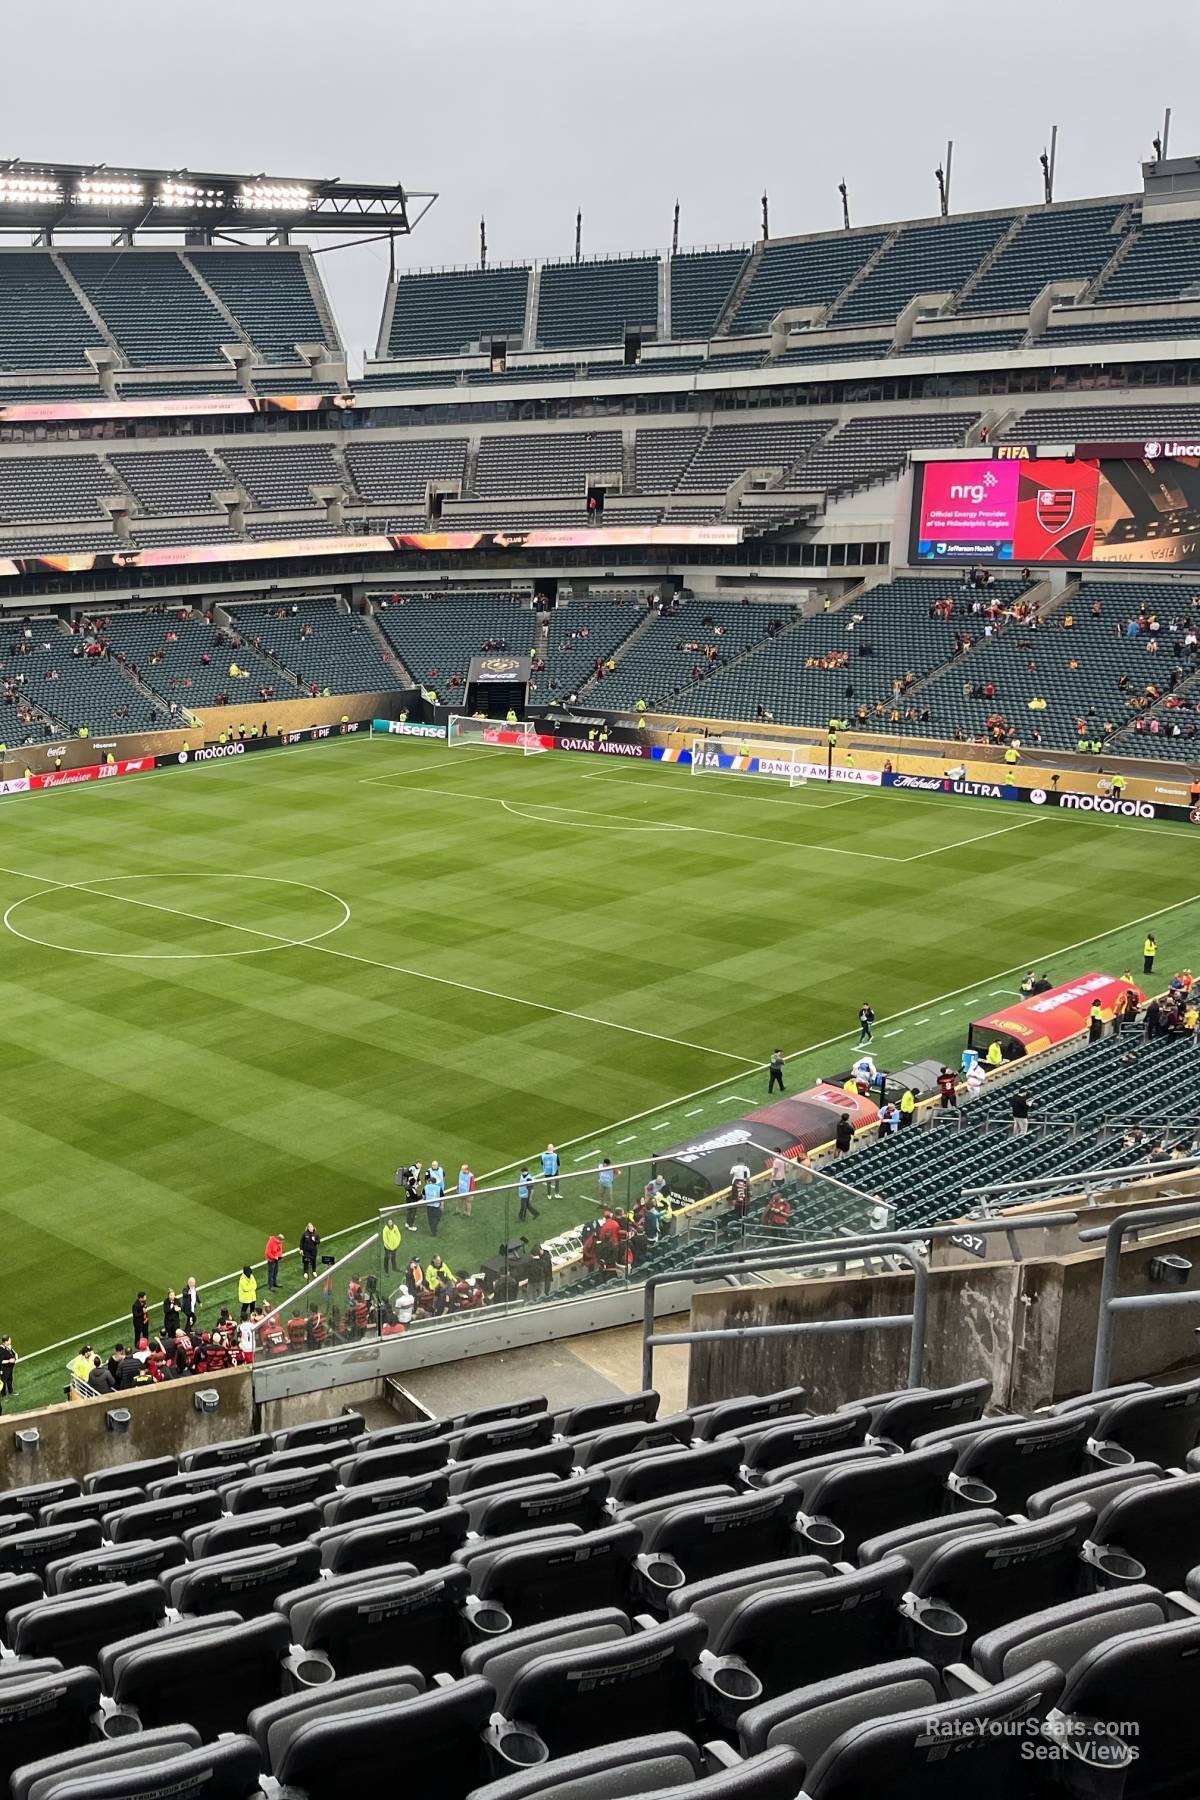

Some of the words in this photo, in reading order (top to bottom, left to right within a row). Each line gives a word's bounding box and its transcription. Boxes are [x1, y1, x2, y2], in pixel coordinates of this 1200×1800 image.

[997, 446, 1030, 460] FIFA
[930, 510, 953, 518] Official
[954, 510, 978, 519] Energy
[978, 510, 1007, 518] Provider
[318, 728, 330, 737] PIF
[347, 722, 359, 732] PIF
[388, 721, 446, 738] Hisense
[289, 733, 301, 743] PIF
[194, 741, 245, 760] motorola
[561, 738, 595, 752] QATAR
[598, 740, 643, 756] AIRWAYS
[689, 751, 720, 767] VISA
[41, 770, 92, 788] Budweiser
[98, 763, 119, 778] ZERO
[761, 760, 790, 773] BANK
[793, 765, 807, 774] OF
[810, 767, 863, 781] AMERICA
[893, 775, 943, 791] Michelob
[953, 781, 1001, 798] ULTRA
[1059, 793, 1156, 819] motorola
